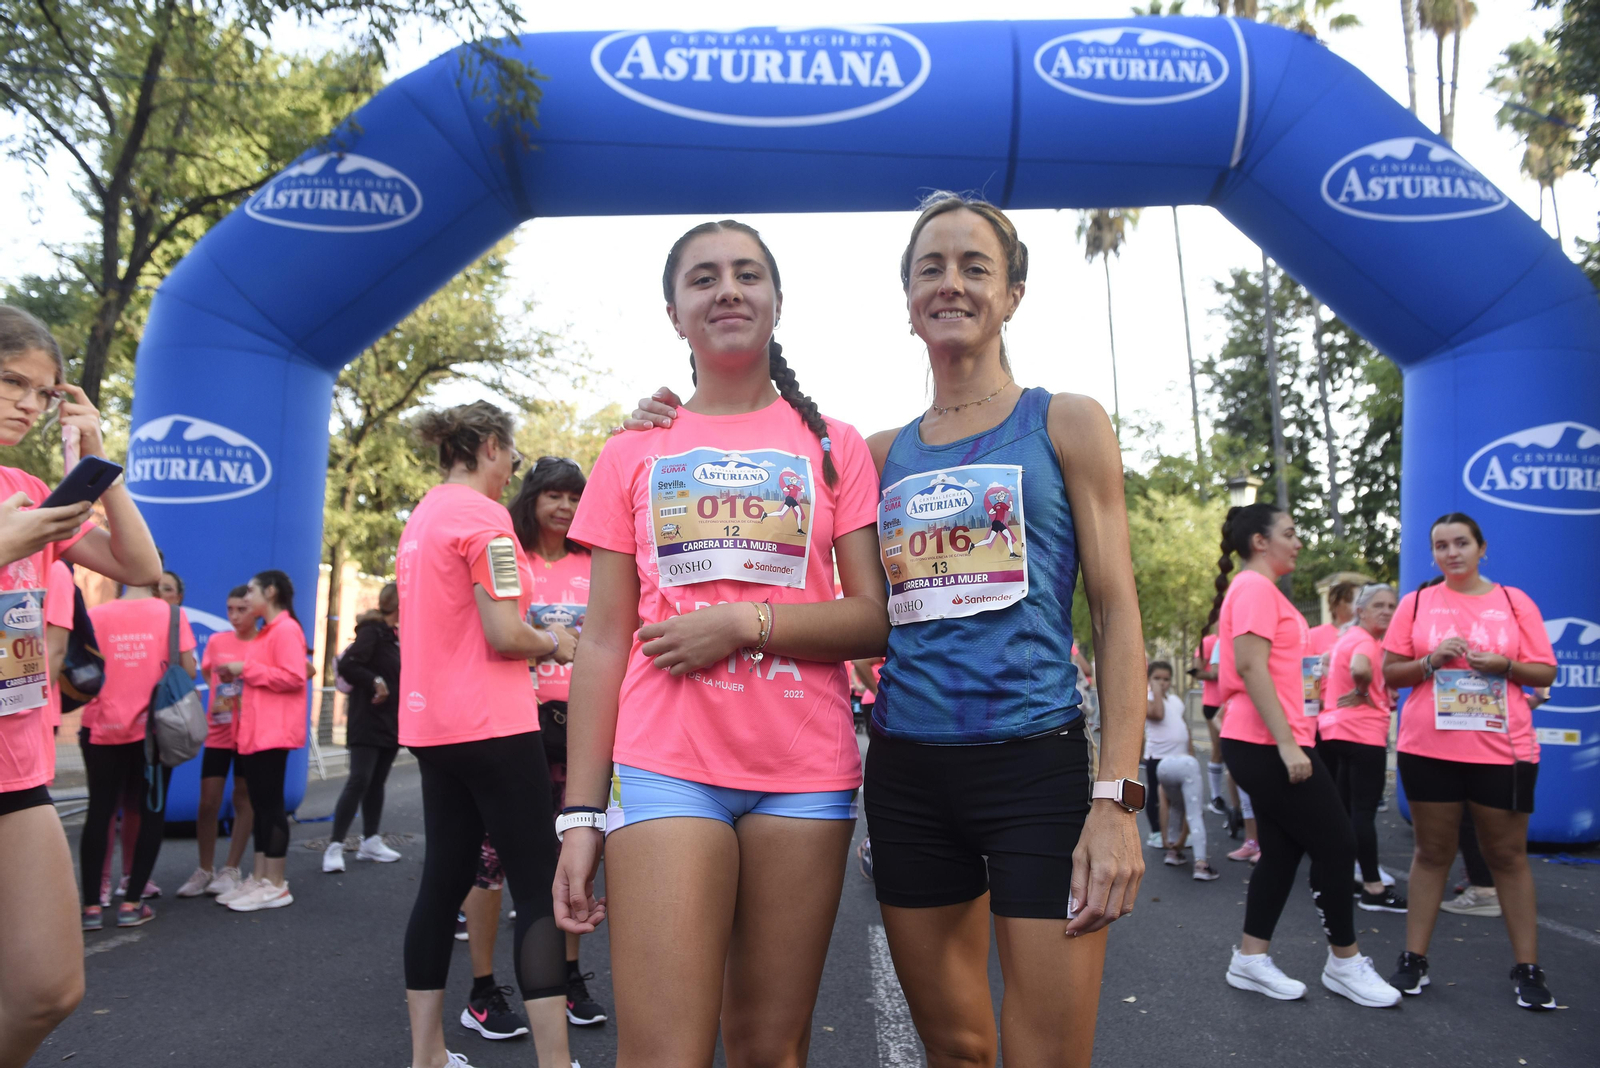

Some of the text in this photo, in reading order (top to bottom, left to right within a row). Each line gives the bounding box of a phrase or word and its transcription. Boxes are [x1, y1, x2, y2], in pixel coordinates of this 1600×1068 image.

[671, 33, 893, 48] CENTRAL LECHERA
[614, 34, 905, 88] ASTURIANA
[1050, 45, 1215, 84] ASTURIANA
[1337, 166, 1501, 203] ASTURIANA
[253, 185, 407, 216] ASTURIANA
[661, 466, 687, 475] SUMA
[698, 467, 765, 481] ASTURIANA
[1479, 455, 1600, 492] ASTURI
[697, 495, 765, 519] 016
[884, 501, 902, 513] SUMA
[909, 497, 969, 515] ASTURIANA
[723, 525, 740, 537] 12
[682, 539, 777, 552] CARRERA DE LA MUJER
[908, 525, 972, 557] 016
[669, 559, 712, 576] OYSHO
[755, 562, 794, 575] Santander
[932, 561, 948, 574] 13
[932, 577, 944, 586] DE
[945, 575, 956, 585] LA
[958, 573, 988, 584] MUJER
[964, 594, 1013, 604] Santander
[108, 632, 154, 643] CARRERA
[12, 637, 44, 659] 016
[116, 642, 145, 652] DE LA
[113, 650, 147, 660] MUJER
[689, 671, 744, 692] DE LA MUJER
[784, 690, 804, 698] 2022
[1458, 692, 1488, 706] 016
